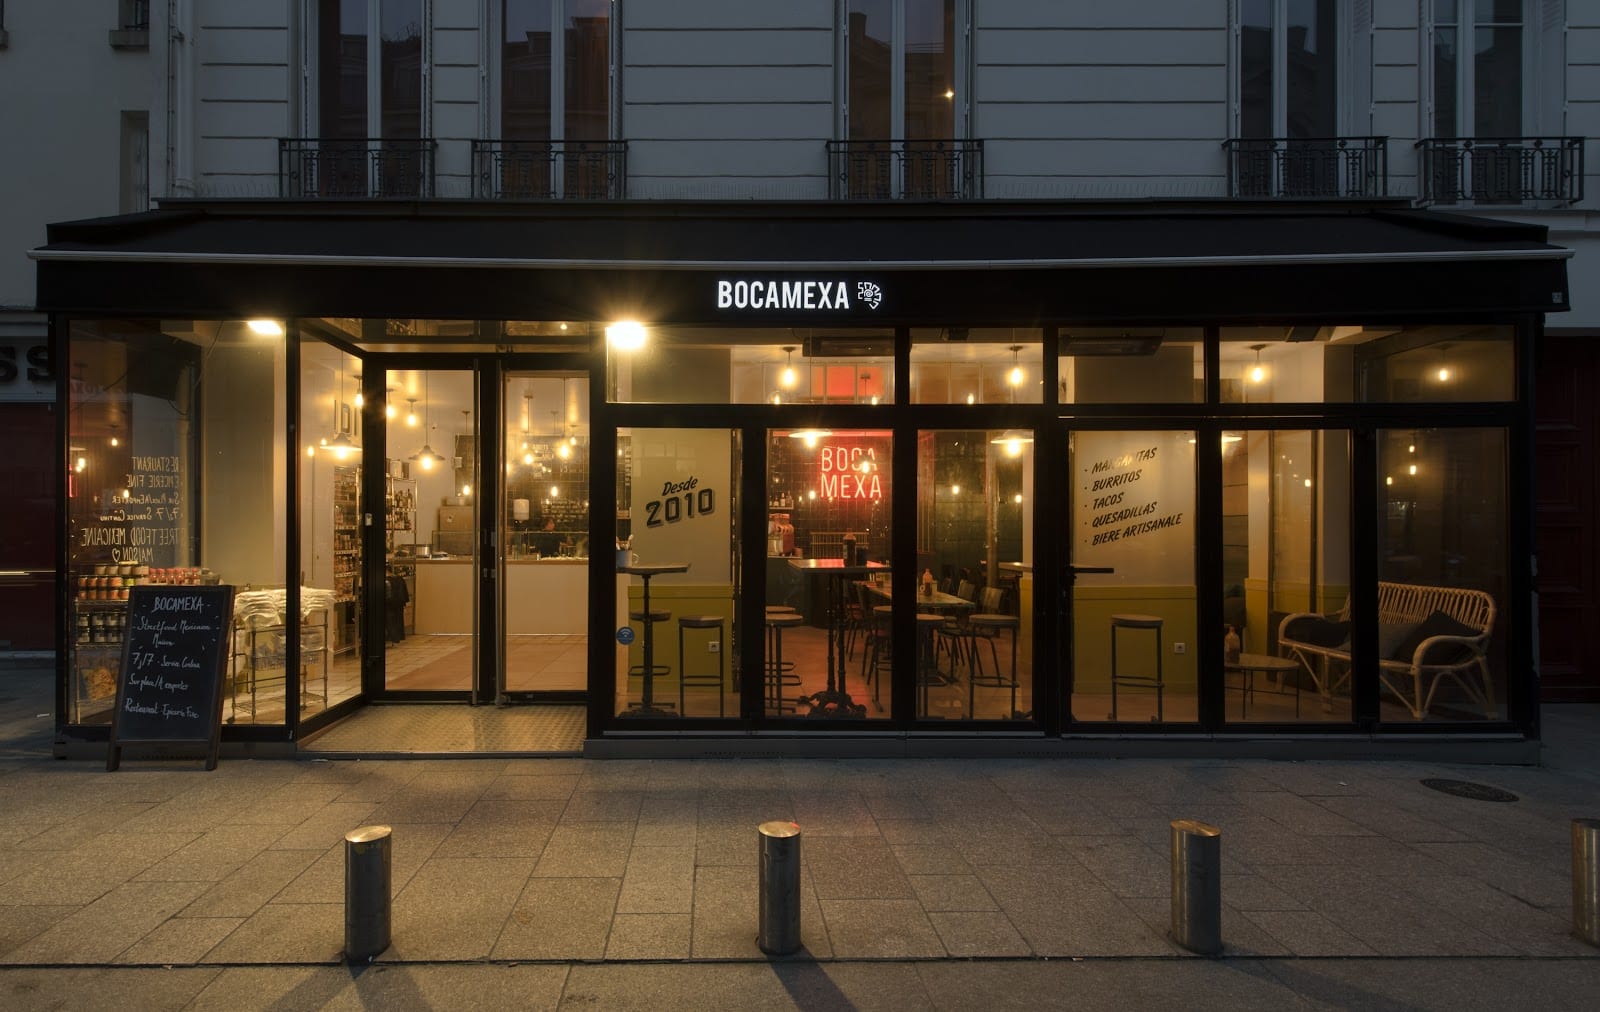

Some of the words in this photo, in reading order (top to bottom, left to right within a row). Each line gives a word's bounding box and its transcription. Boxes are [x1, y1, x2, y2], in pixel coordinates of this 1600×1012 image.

[718, 280, 850, 309] BOCAMEXA
[821, 447, 878, 472] BOCA
[662, 475, 699, 497] Desde
[820, 473, 882, 499] MEXA
[1092, 469, 1143, 492] BURRITOS
[645, 488, 715, 529] 2010
[1093, 492, 1125, 510] TACOS
[1092, 501, 1158, 528] QUESADILLAS
[1092, 529, 1122, 546] BIERE
[1122, 513, 1183, 539] ARTISANALE
[151, 596, 205, 614] BOCAMEXA
